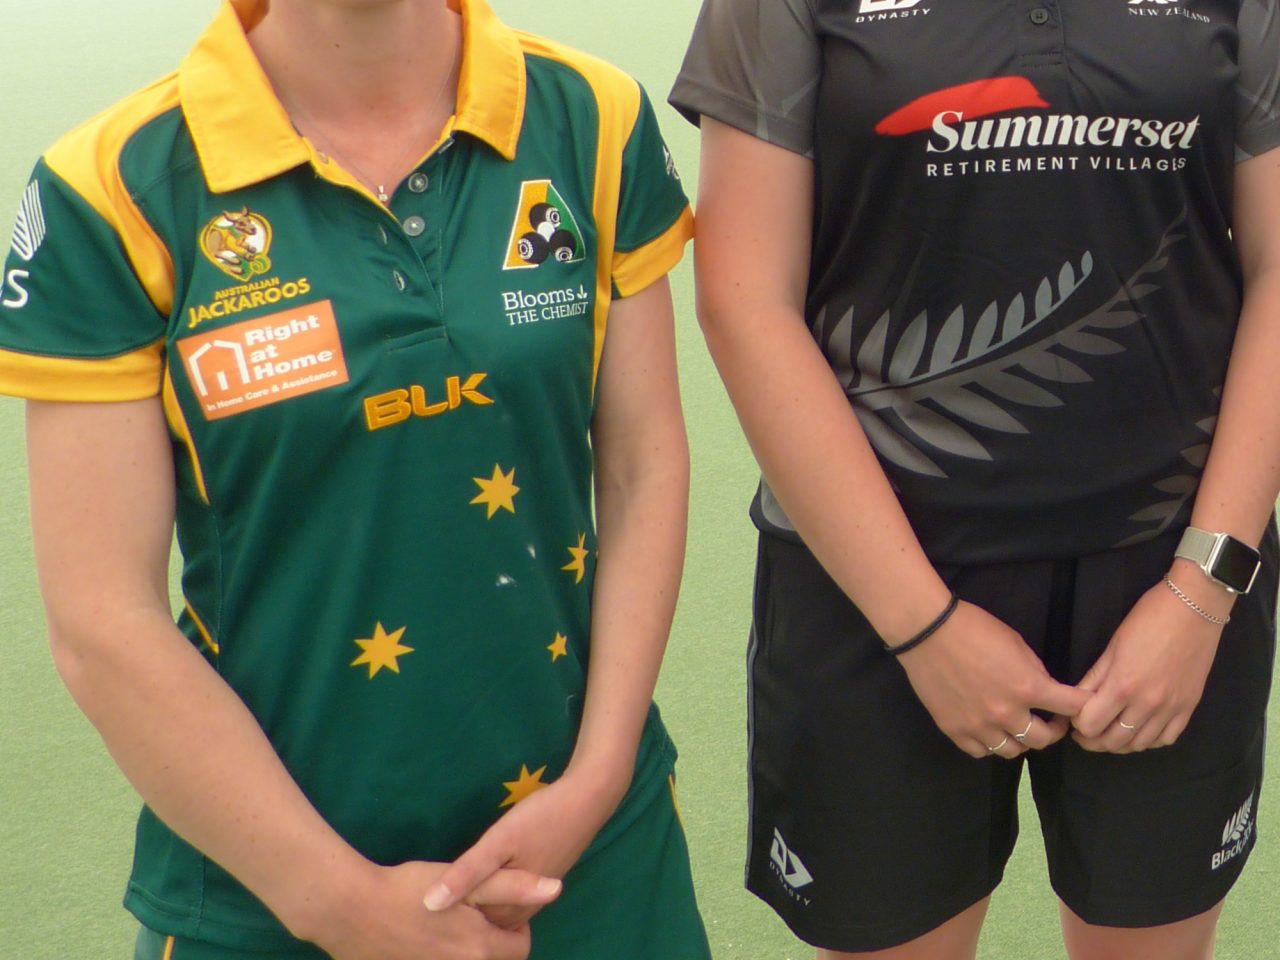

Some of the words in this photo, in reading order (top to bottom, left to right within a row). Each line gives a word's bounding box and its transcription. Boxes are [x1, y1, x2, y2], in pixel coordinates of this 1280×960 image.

[855, 8, 931, 23] DYNASTY
[1128, 7, 1159, 16] NEW
[1165, 6, 1211, 23] ZEALAND
[926, 110, 1200, 153] Summerset
[926, 156, 1080, 177] RETIREMENT
[214, 276, 280, 301] AUSTRALIAN
[502, 288, 575, 311] Blooms
[187, 277, 311, 329] JACKAROOS
[506, 309, 539, 326] THE
[541, 301, 589, 320] CHEMIST
[244, 314, 321, 346] Right
[250, 344, 279, 363] at
[253, 350, 333, 381] Home
[216, 396, 244, 409] Home
[244, 388, 269, 401] Care
[363, 372, 495, 431] BLK
